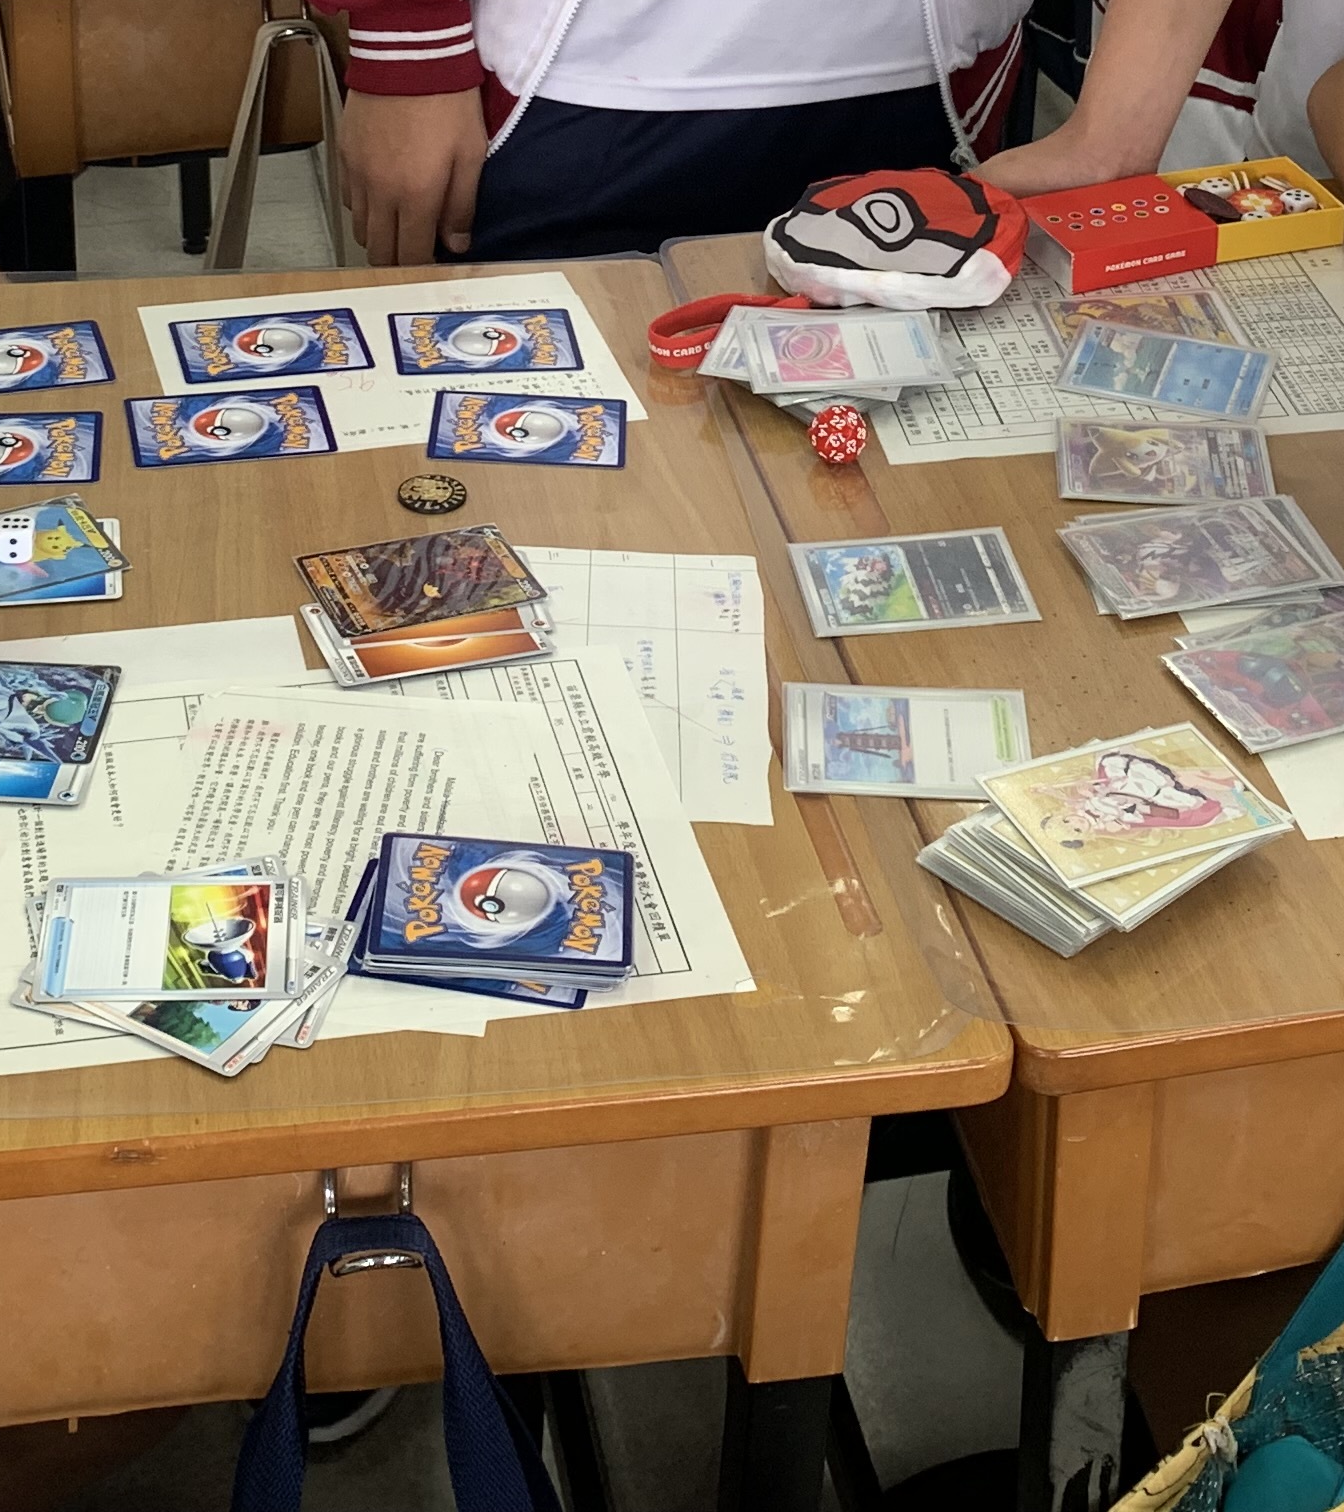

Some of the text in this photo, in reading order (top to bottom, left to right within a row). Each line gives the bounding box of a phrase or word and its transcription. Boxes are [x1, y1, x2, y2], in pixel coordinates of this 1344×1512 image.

[1143, 254, 1164, 266] CARD
[1165, 249, 1186, 261] GAME
[672, 344, 702, 358] CARD
[830, 416, 846, 429] 22
[333, 726, 346, 743] books
[347, 733, 364, 756] glorious
[282, 749, 298, 780] Education
[408, 745, 425, 771] suffering
[303, 763, 315, 778] book
[340, 759, 357, 783] struggle
[364, 764, 378, 789] brothers
[425, 768, 438, 793] brothers
[333, 785, 350, 807] against
[381, 776, 396, 801] children
[271, 797, 284, 816] Thank
[398, 789, 414, 812] poverty
[352, 803, 368, 825] waiting
[278, 834, 294, 858] change
[319, 838, 336, 860] poverty
[335, 865, 352, 892] peaceful
[290, 879, 299, 919] TRAINER
[331, 894, 344, 913] future
[294, 968, 336, 1006] TRAINER
